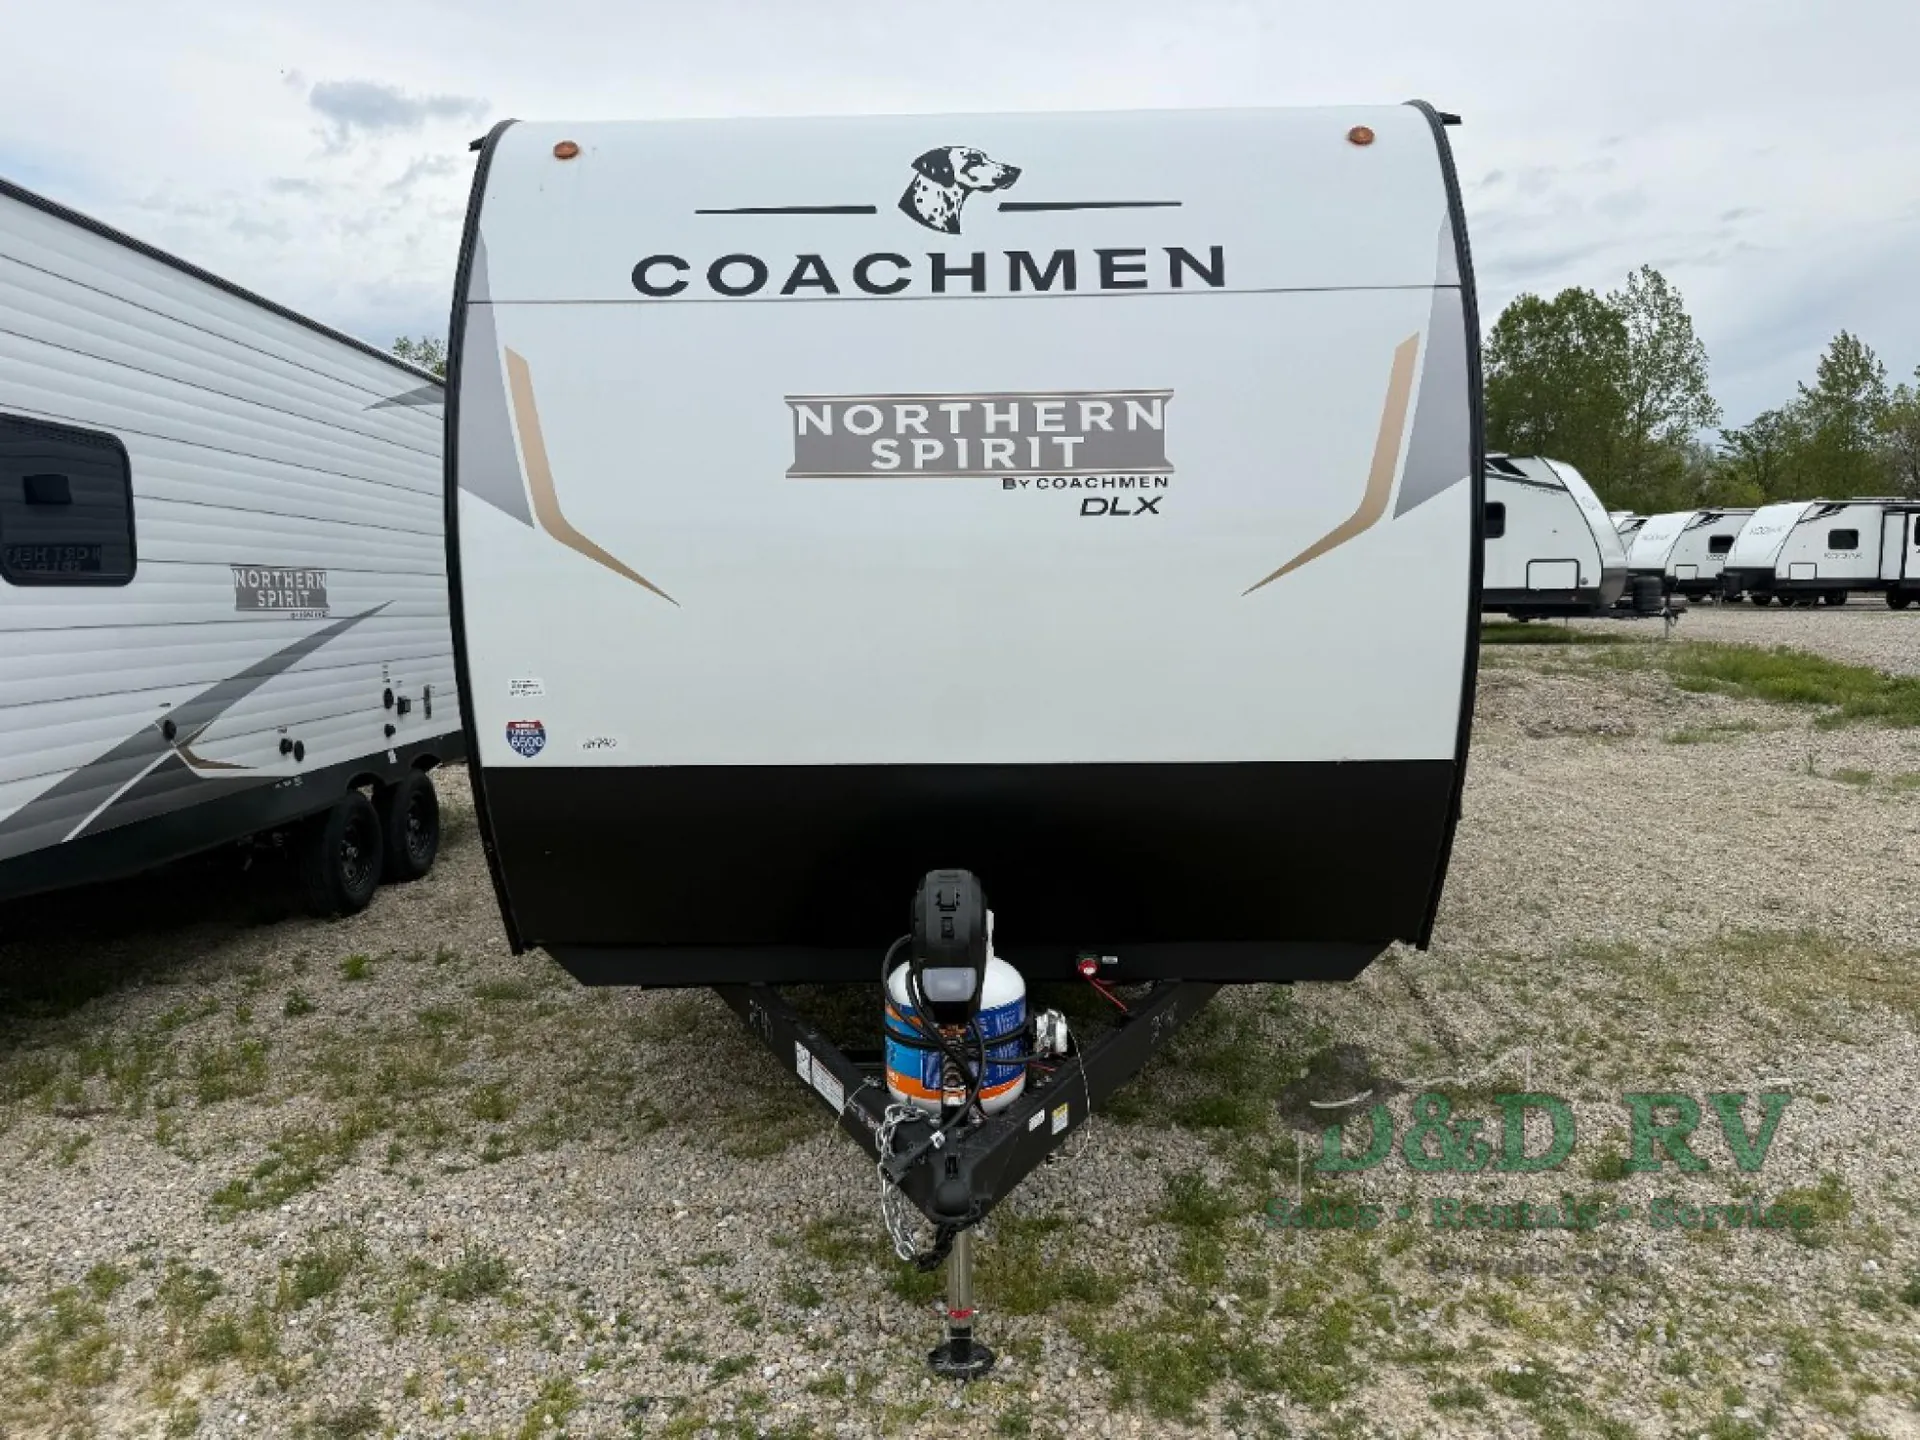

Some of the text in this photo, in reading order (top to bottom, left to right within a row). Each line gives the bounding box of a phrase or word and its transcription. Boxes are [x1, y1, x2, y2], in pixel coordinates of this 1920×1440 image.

[631, 246, 1226, 297] COACHMEN
[796, 399, 1163, 435] NORTHERN
[871, 436, 1085, 470] SPIRIT
[1036, 476, 1168, 490] COACHMEN
[1079, 496, 1164, 517] DLX
[235, 569, 326, 588] NORTHERN
[257, 589, 310, 607] SPIRIT
